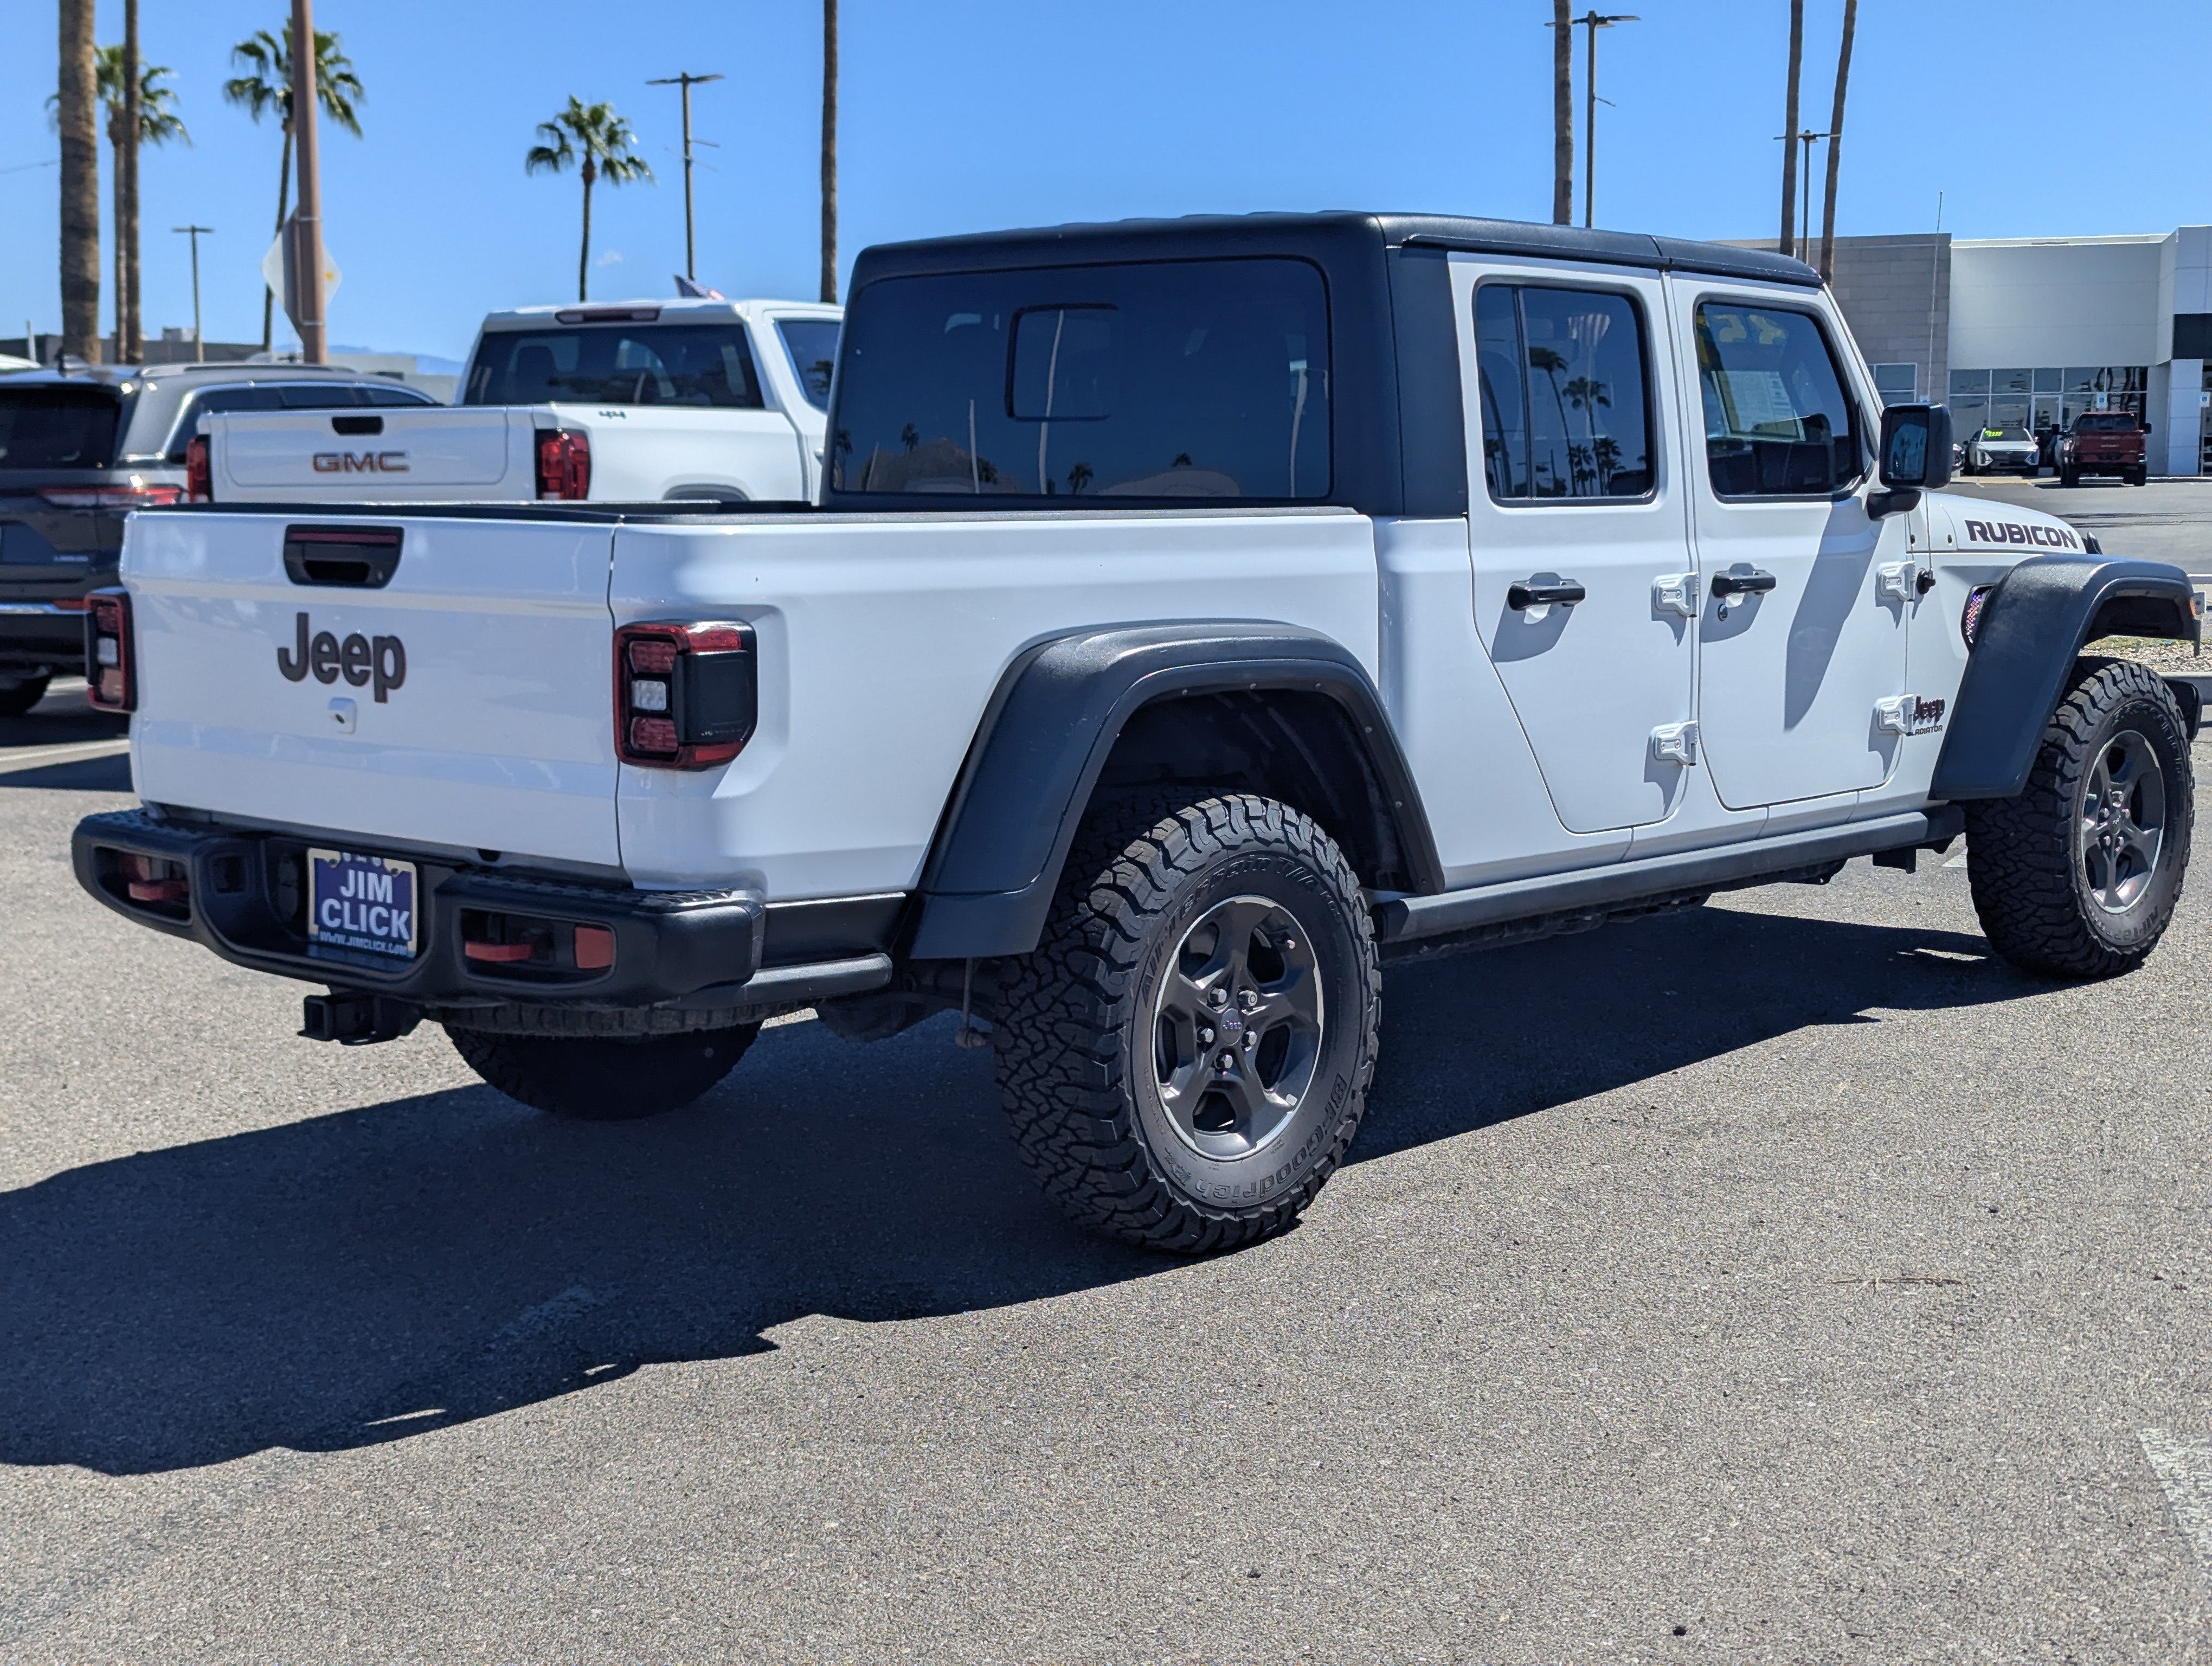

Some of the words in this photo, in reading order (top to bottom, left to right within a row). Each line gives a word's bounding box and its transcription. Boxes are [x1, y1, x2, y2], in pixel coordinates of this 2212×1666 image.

[312, 451, 409, 472] GMC
[1964, 520, 2078, 549] RUBICON
[277, 612, 407, 703] Jeep
[1913, 695, 1945, 722] Jeep
[339, 869, 393, 904] JIM
[321, 898, 410, 941] CLICK
[1195, 1072, 1348, 1204] BFGoodrich
